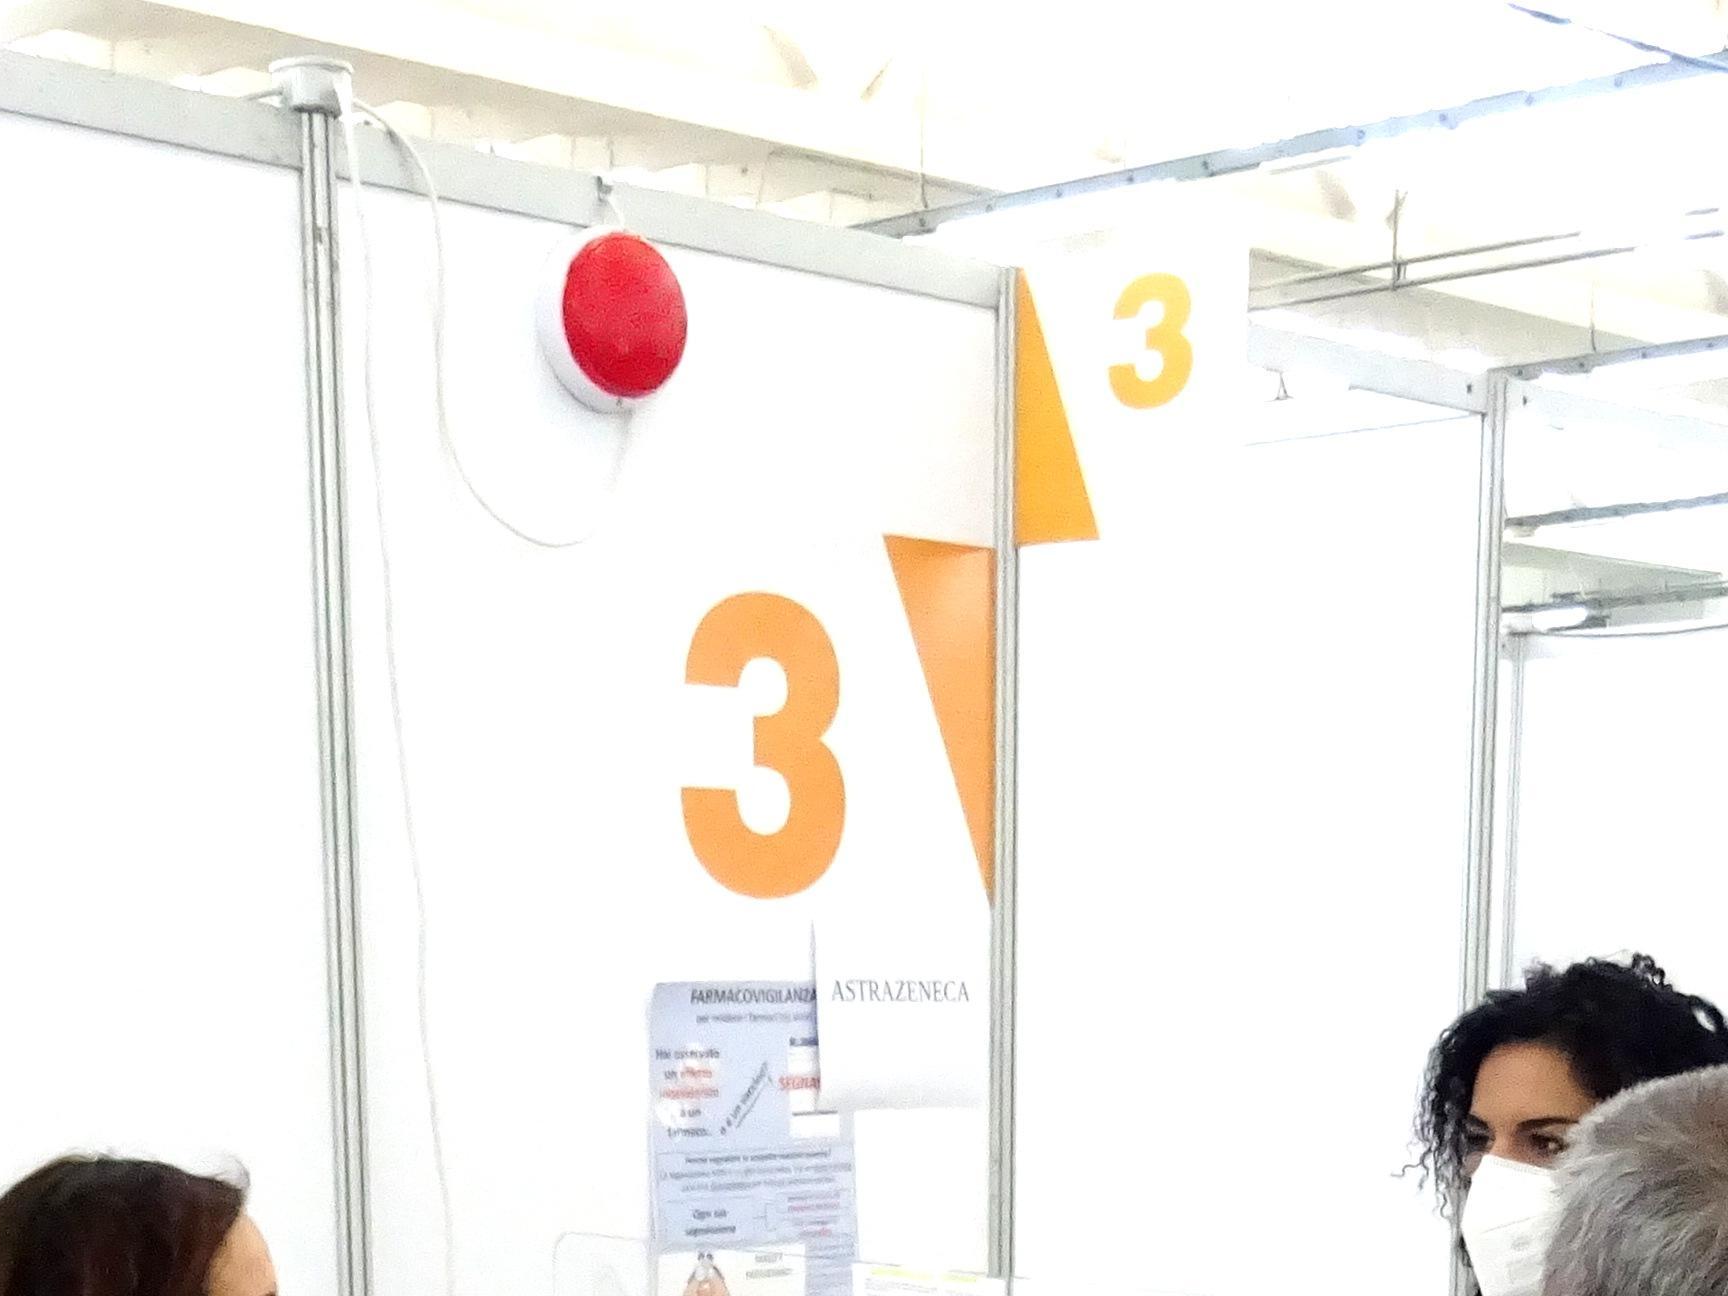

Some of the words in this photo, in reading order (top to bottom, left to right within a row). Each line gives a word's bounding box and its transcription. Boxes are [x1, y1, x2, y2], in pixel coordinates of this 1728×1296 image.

[1108, 272, 1194, 409] 3
[679, 590, 847, 900] 3
[689, 986, 818, 1005] FARMACOVIGILANZA
[831, 979, 970, 1003] ASTRAZENECA
